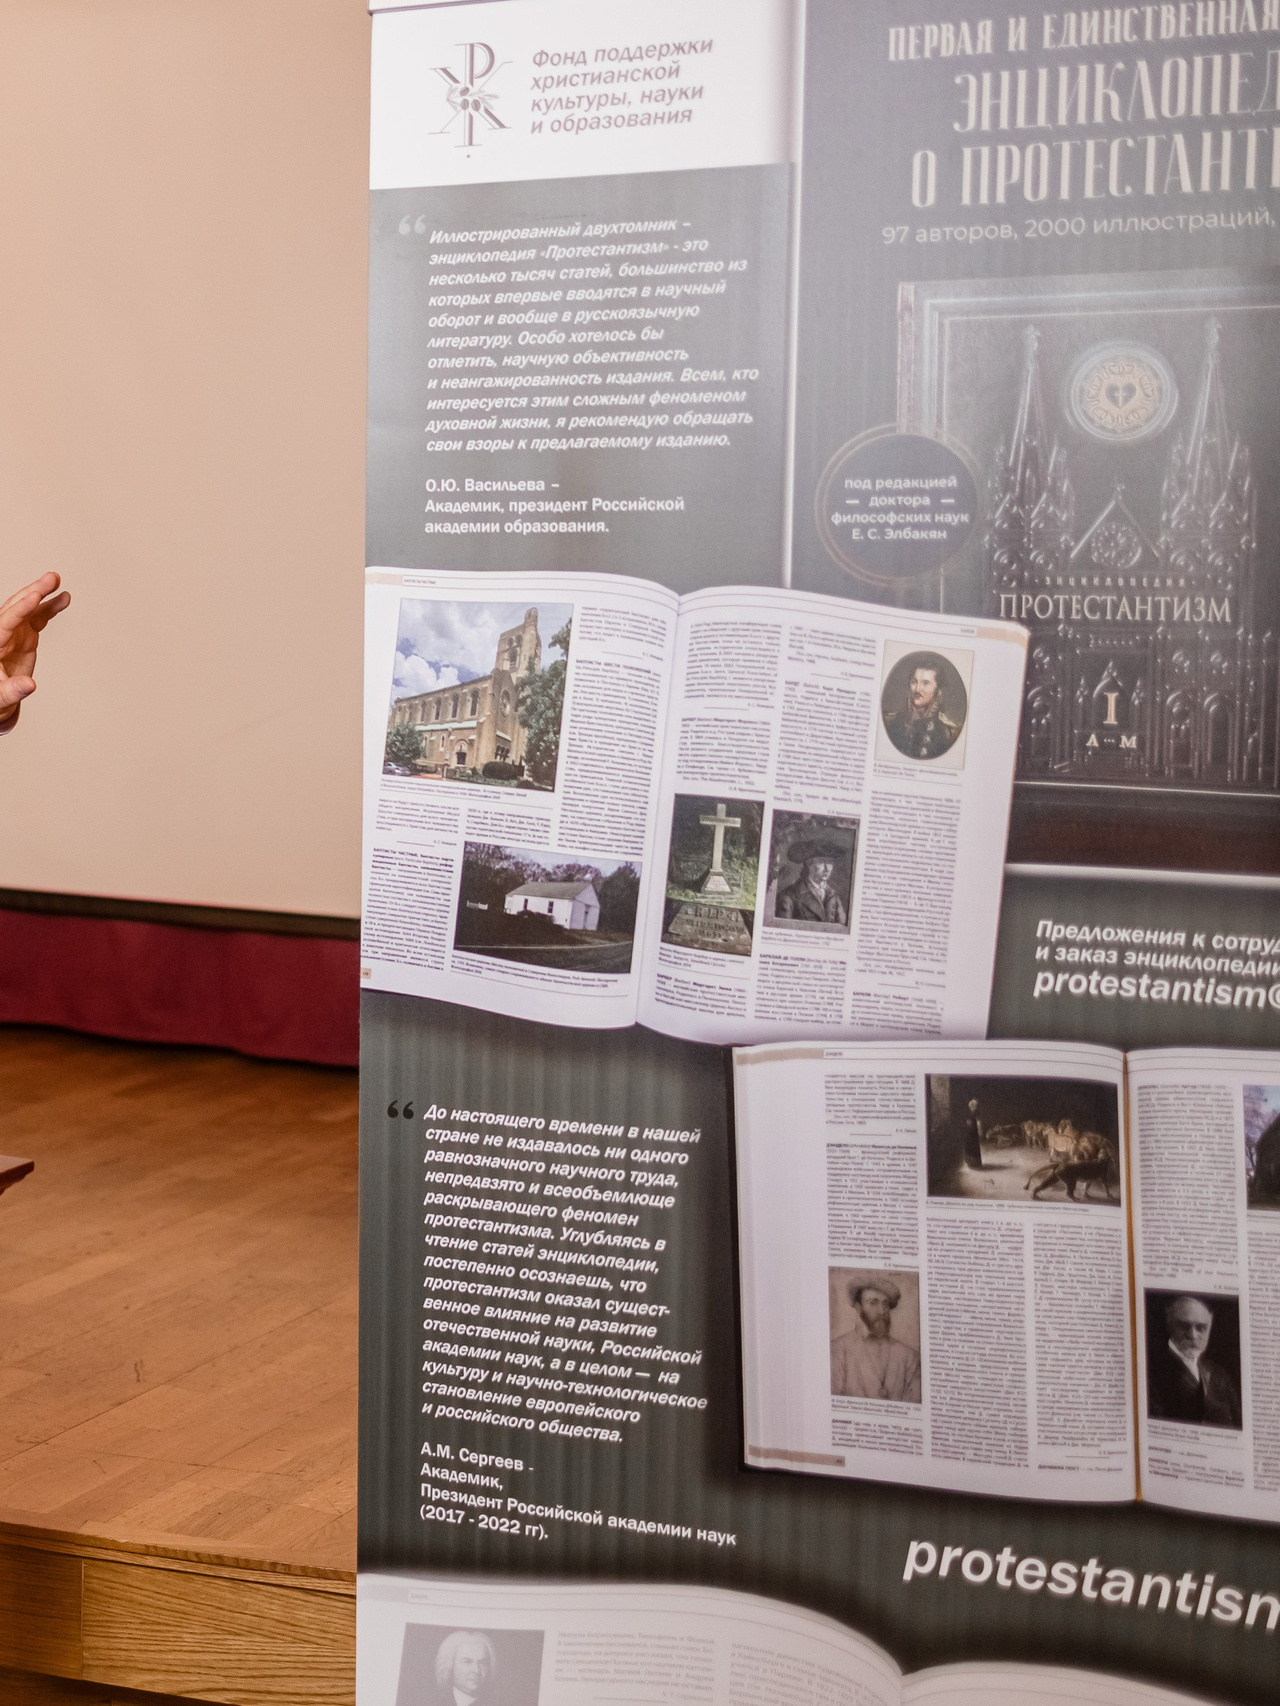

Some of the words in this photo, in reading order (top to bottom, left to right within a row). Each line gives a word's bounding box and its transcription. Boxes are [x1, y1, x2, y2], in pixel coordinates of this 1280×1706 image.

[888, 20, 991, 60] ПЕРВАЯ
[1008, 17, 1026, 51] И
[1042, 0, 1280, 48] ЕДИНСТВЕННАЯ
[532, 49, 587, 67] Фонд
[594, 39, 713, 62] поддержки
[530, 62, 680, 91] христианской
[531, 91, 631, 115] культуры,
[640, 85, 703, 106] науки
[530, 120, 543, 134] и
[550, 108, 692, 134] образования
[911, 150, 935, 207] О
[429, 222, 581, 244] Иллюстрированный
[582, 220, 677, 237] двухтомник
[882, 225, 909, 244] 97
[915, 224, 1017, 244] авторов,
[1024, 216, 1085, 237] 2000
[1093, 206, 1275, 233] иллюстраций,
[428, 248, 536, 265] энциклопедия
[681, 239, 708, 251] это
[428, 271, 506, 285] несколько
[510, 269, 555, 281] тысяч
[559, 263, 612, 279] статей,
[618, 260, 724, 276] большинство
[727, 259, 747, 270] из
[428, 293, 491, 308] которых
[494, 290, 562, 305] впервые
[565, 286, 637, 300] вводятся
[640, 286, 651, 297] в
[654, 279, 726, 298] научный
[428, 312, 481, 328] оборот
[483, 314, 494, 324] и
[497, 309, 558, 324] вообще
[561, 311, 572, 321] в
[573, 305, 699, 324] русскоязычную
[426, 334, 512, 349] литературу.
[517, 329, 565, 344] Особо
[567, 330, 636, 342] хотелось
[640, 325, 664, 340] бы
[427, 356, 496, 368] отметить,
[501, 353, 569, 368] научную
[572, 349, 688, 363] объективность
[426, 378, 437, 388] и
[440, 373, 602, 389] неангажированность
[605, 371, 674, 384] издания.
[680, 367, 725, 381] Всем,
[731, 368, 759, 379] кто
[426, 396, 528, 411] интересуется
[530, 395, 569, 407] этим
[572, 393, 645, 406] сложным
[648, 390, 746, 406] феноменом
[424, 415, 497, 433] духовной
[498, 417, 550, 428] жизни,
[554, 416, 566, 427] я
[567, 414, 669, 430] рекомендую
[672, 410, 752, 427] обращать
[426, 440, 462, 451] свои
[465, 439, 514, 452] взоры
[517, 439, 527, 449] к
[530, 436, 653, 451] предлагаемому
[655, 434, 730, 447] изданию.
[425, 478, 459, 492] О.Ю.
[464, 478, 544, 491] Васильева
[844, 479, 871, 490] под
[876, 476, 957, 490] редакцией
[424, 499, 504, 513] Академик,
[508, 500, 588, 514] президент
[592, 496, 684, 511] Российской
[869, 496, 930, 508] доктора
[424, 522, 499, 534] академии
[503, 518, 608, 535] образования.
[831, 512, 931, 526] философских
[935, 514, 969, 525] наук
[884, 528, 946, 540] Элбакян
[1000, 594, 1232, 622] ПРОТЕСТАНТИЗМ
[1035, 919, 1186, 946] Предложения
[1192, 933, 1205, 948] к
[1034, 945, 1049, 960] и
[1054, 946, 1117, 963] заказ
[423, 1104, 446, 1120] До
[450, 1109, 545, 1129] настоящего
[548, 1119, 624, 1136] времени
[627, 1126, 639, 1138] в
[642, 1127, 700, 1142] нашей
[425, 1128, 479, 1144] стране
[482, 1134, 503, 1146] не
[506, 1136, 600, 1156] издавалось
[604, 1146, 626, 1159] ни
[630, 1148, 688, 1164] одного
[423, 1149, 545, 1173] равнозначного
[548, 1163, 625, 1180] научного
[630, 1170, 678, 1187] труда,
[424, 1170, 525, 1192] непредвзято
[528, 1182, 540, 1194] и
[542, 1184, 675, 1208] всеобъемлюще
[423, 1192, 557, 1217] раскрывающего
[561, 1205, 639, 1226] феномен
[423, 1213, 554, 1239] протестантизма.
[559, 1226, 650, 1249] Углубляясь
[654, 1239, 666, 1250] в
[424, 1234, 478, 1251] чтение
[481, 1241, 534, 1258] статей
[536, 1248, 658, 1273] энциклопедии,
[423, 1255, 515, 1277] постепенно
[518, 1268, 613, 1290] осознаешь,
[619, 1279, 646, 1292] что
[423, 1276, 541, 1302] протестантизм
[544, 1292, 600, 1309] оказал
[604, 1299, 670, 1316] сущест-
[422, 1297, 480, 1315] венное
[483, 1306, 550, 1324] влияние
[554, 1315, 575, 1328] на
[577, 1318, 657, 1337] развитие
[422, 1318, 540, 1345] отечественной
[542, 1335, 594, 1354] науки,
[600, 1339, 702, 1364] Российской
[422, 1339, 501, 1361] академии
[504, 1351, 544, 1369] наук,
[549, 1358, 561, 1369] а
[564, 1360, 575, 1371] в
[578, 1361, 632, 1378] целом
[657, 1371, 680, 1384] на
[422, 1360, 489, 1382] культуру
[491, 1371, 502, 1382] и
[505, 1373, 707, 1408] научно-технологическое
[422, 1381, 522, 1406] становление
[525, 1397, 640, 1422] европейского
[421, 1402, 432, 1413] и
[434, 1404, 534, 1429] российского
[538, 1419, 622, 1442] общества.
[420, 1441, 454, 1459] А.М.
[458, 1447, 523, 1470] Сергеев
[420, 1462, 502, 1490] Академик,
[419, 1504, 465, 1523] (2017
[478, 1514, 520, 1533] 2022
[525, 1523, 547, 1540] гг).
[420, 1482, 503, 1509] Президент
[507, 1497, 602, 1525] Российской
[607, 1515, 691, 1538] академии
[696, 1528, 735, 1546] наук
